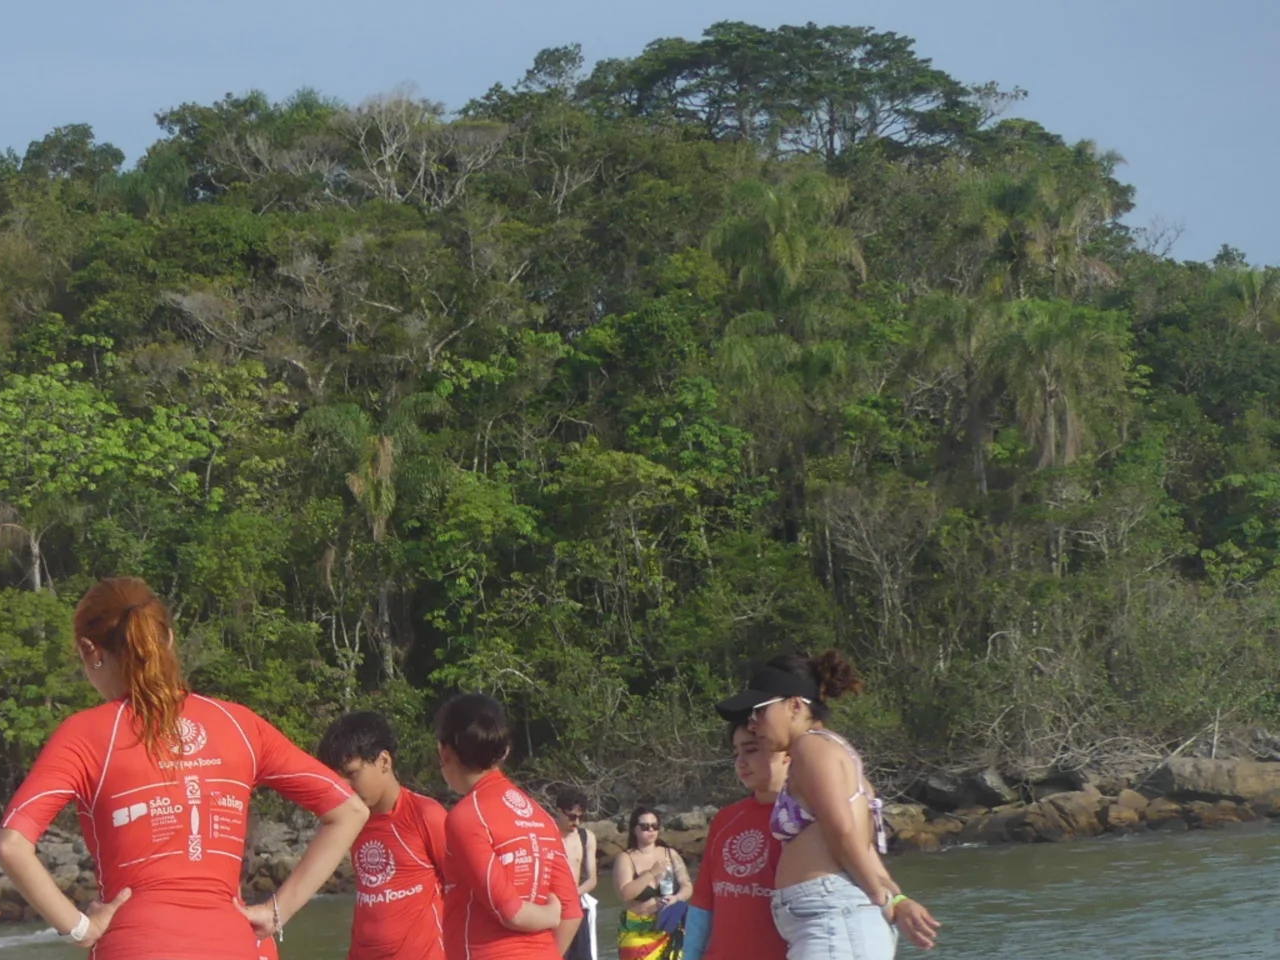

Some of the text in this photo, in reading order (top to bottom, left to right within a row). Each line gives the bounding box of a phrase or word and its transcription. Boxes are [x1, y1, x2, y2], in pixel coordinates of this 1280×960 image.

[150, 796, 171, 807] SÃO
[151, 804, 183, 817] PAULO
[384, 884, 424, 903] TODOS
